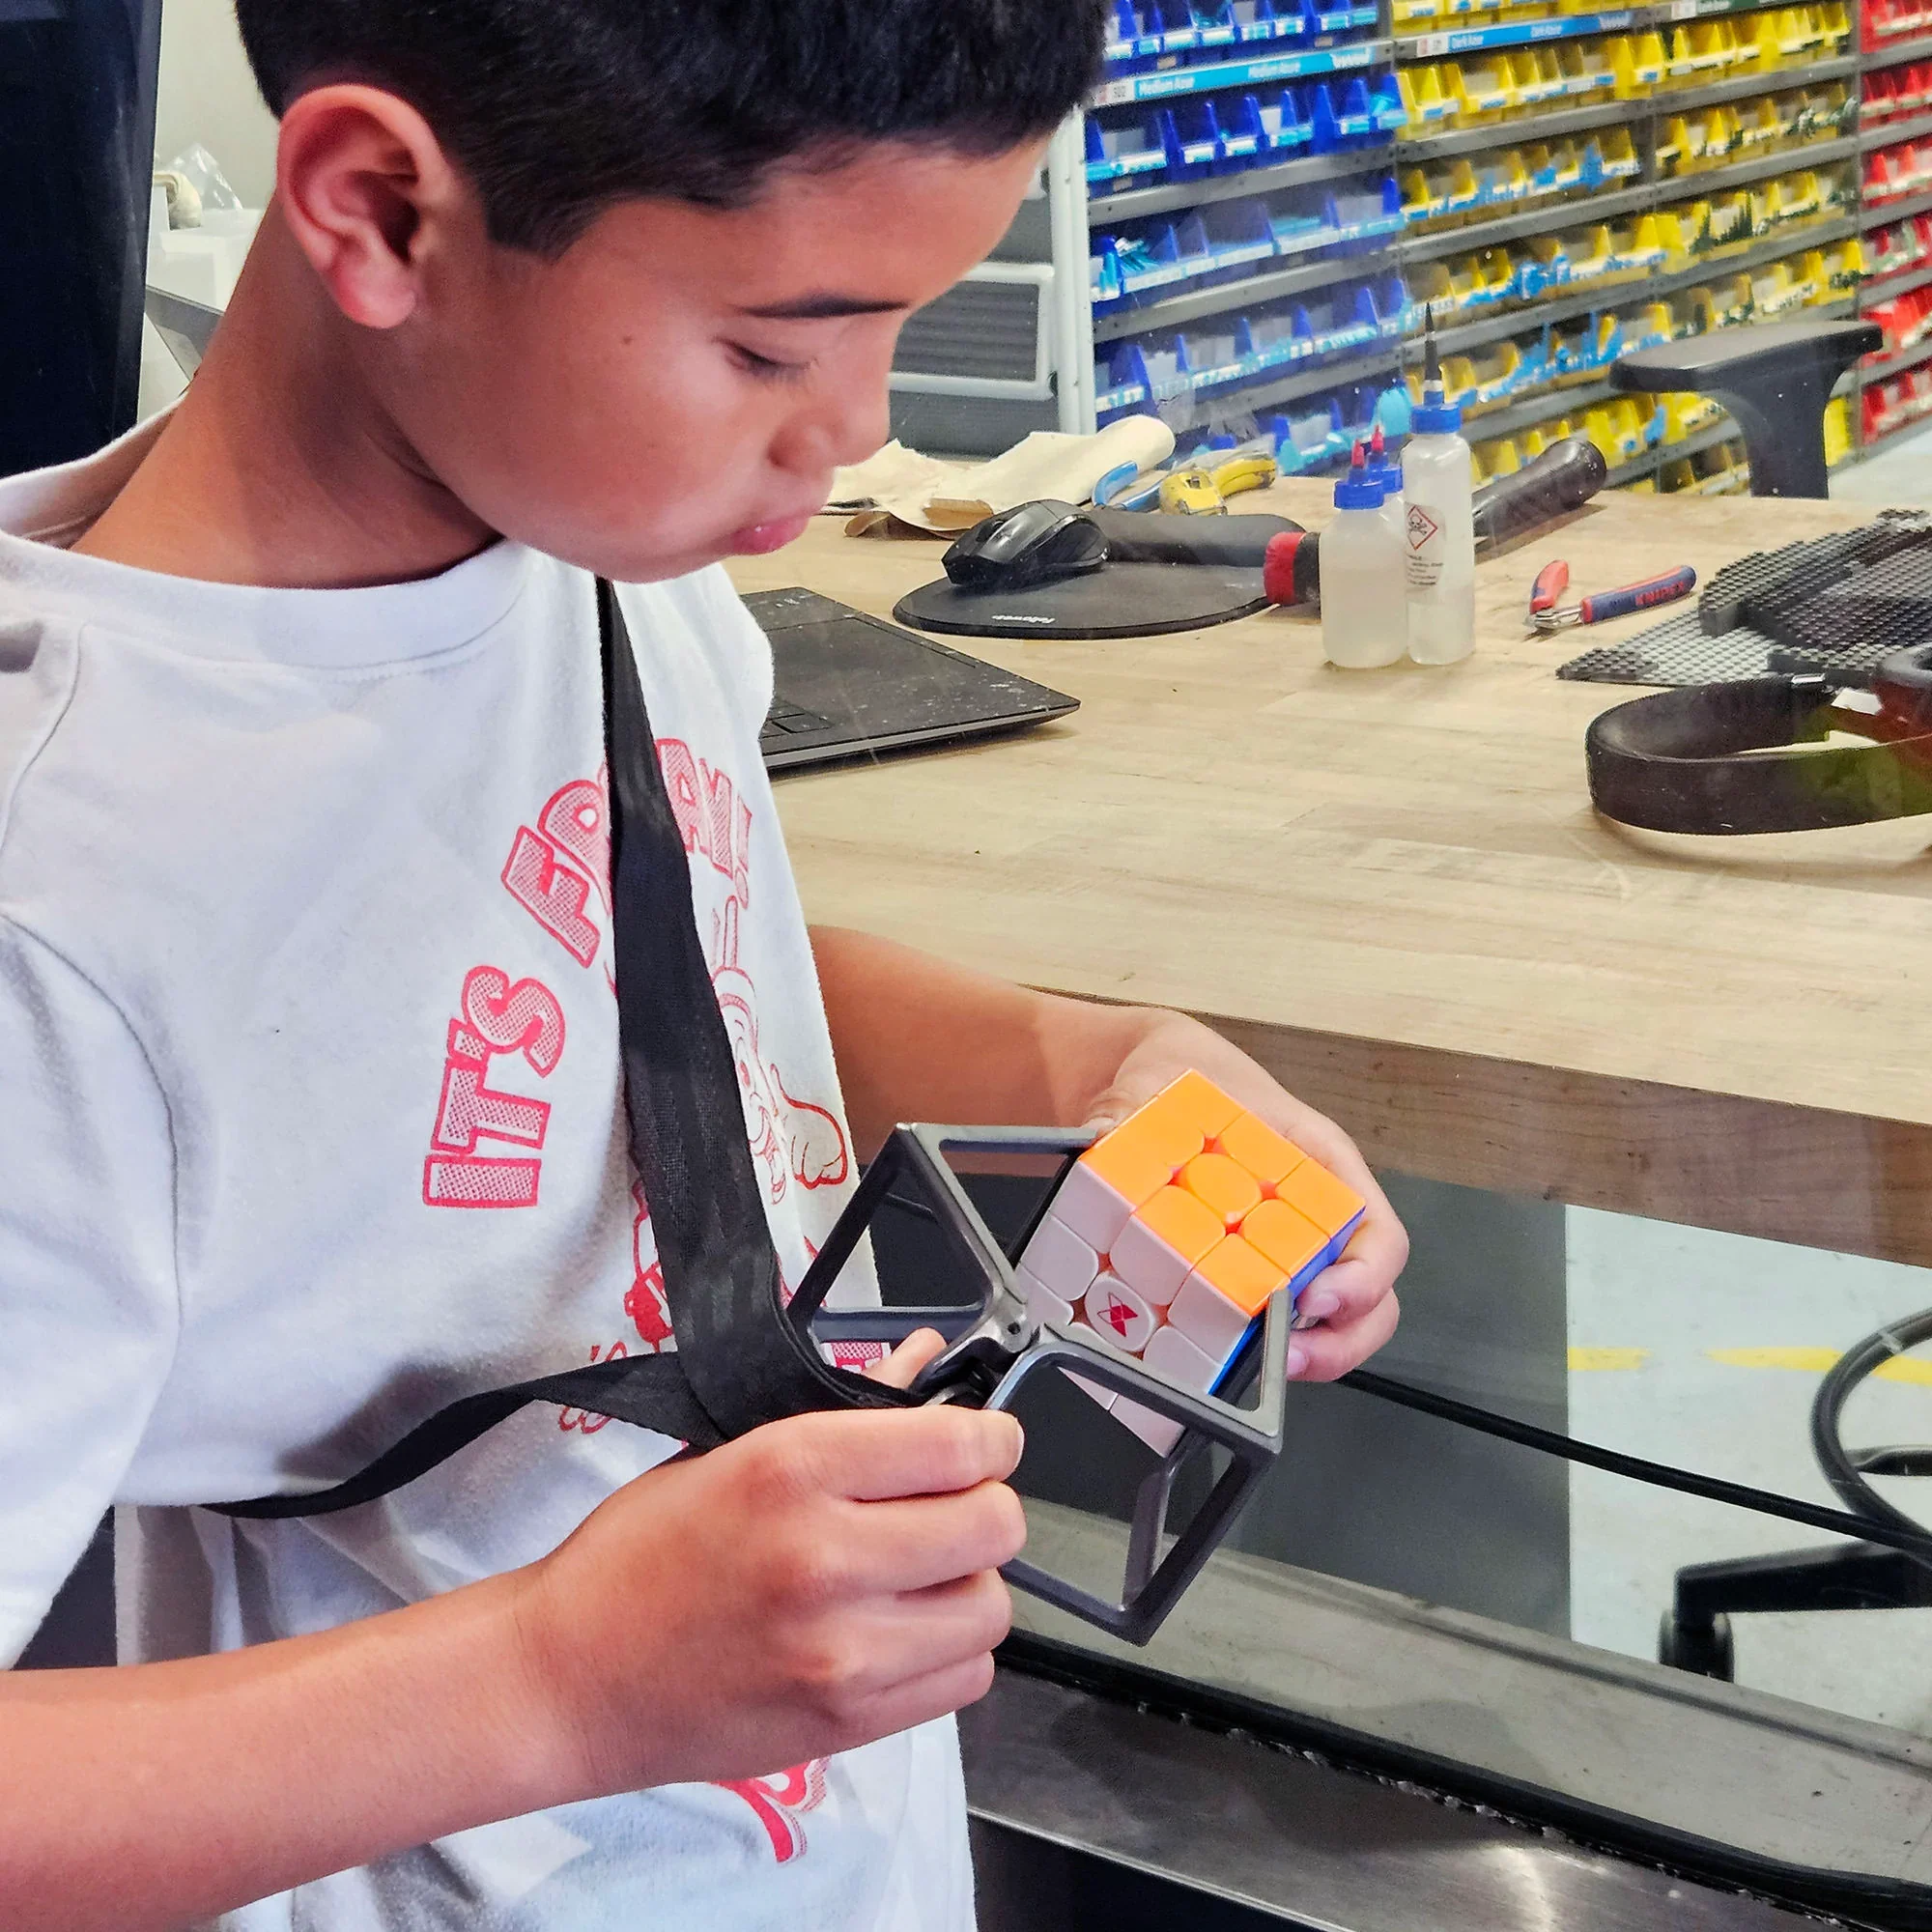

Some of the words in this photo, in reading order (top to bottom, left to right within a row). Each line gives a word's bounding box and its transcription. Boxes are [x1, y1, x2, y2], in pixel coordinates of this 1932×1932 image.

[1635, 581, 1685, 607] KNIPEX
[422, 964, 567, 1208] IT'S
[500, 737, 753, 969] FRAY!
